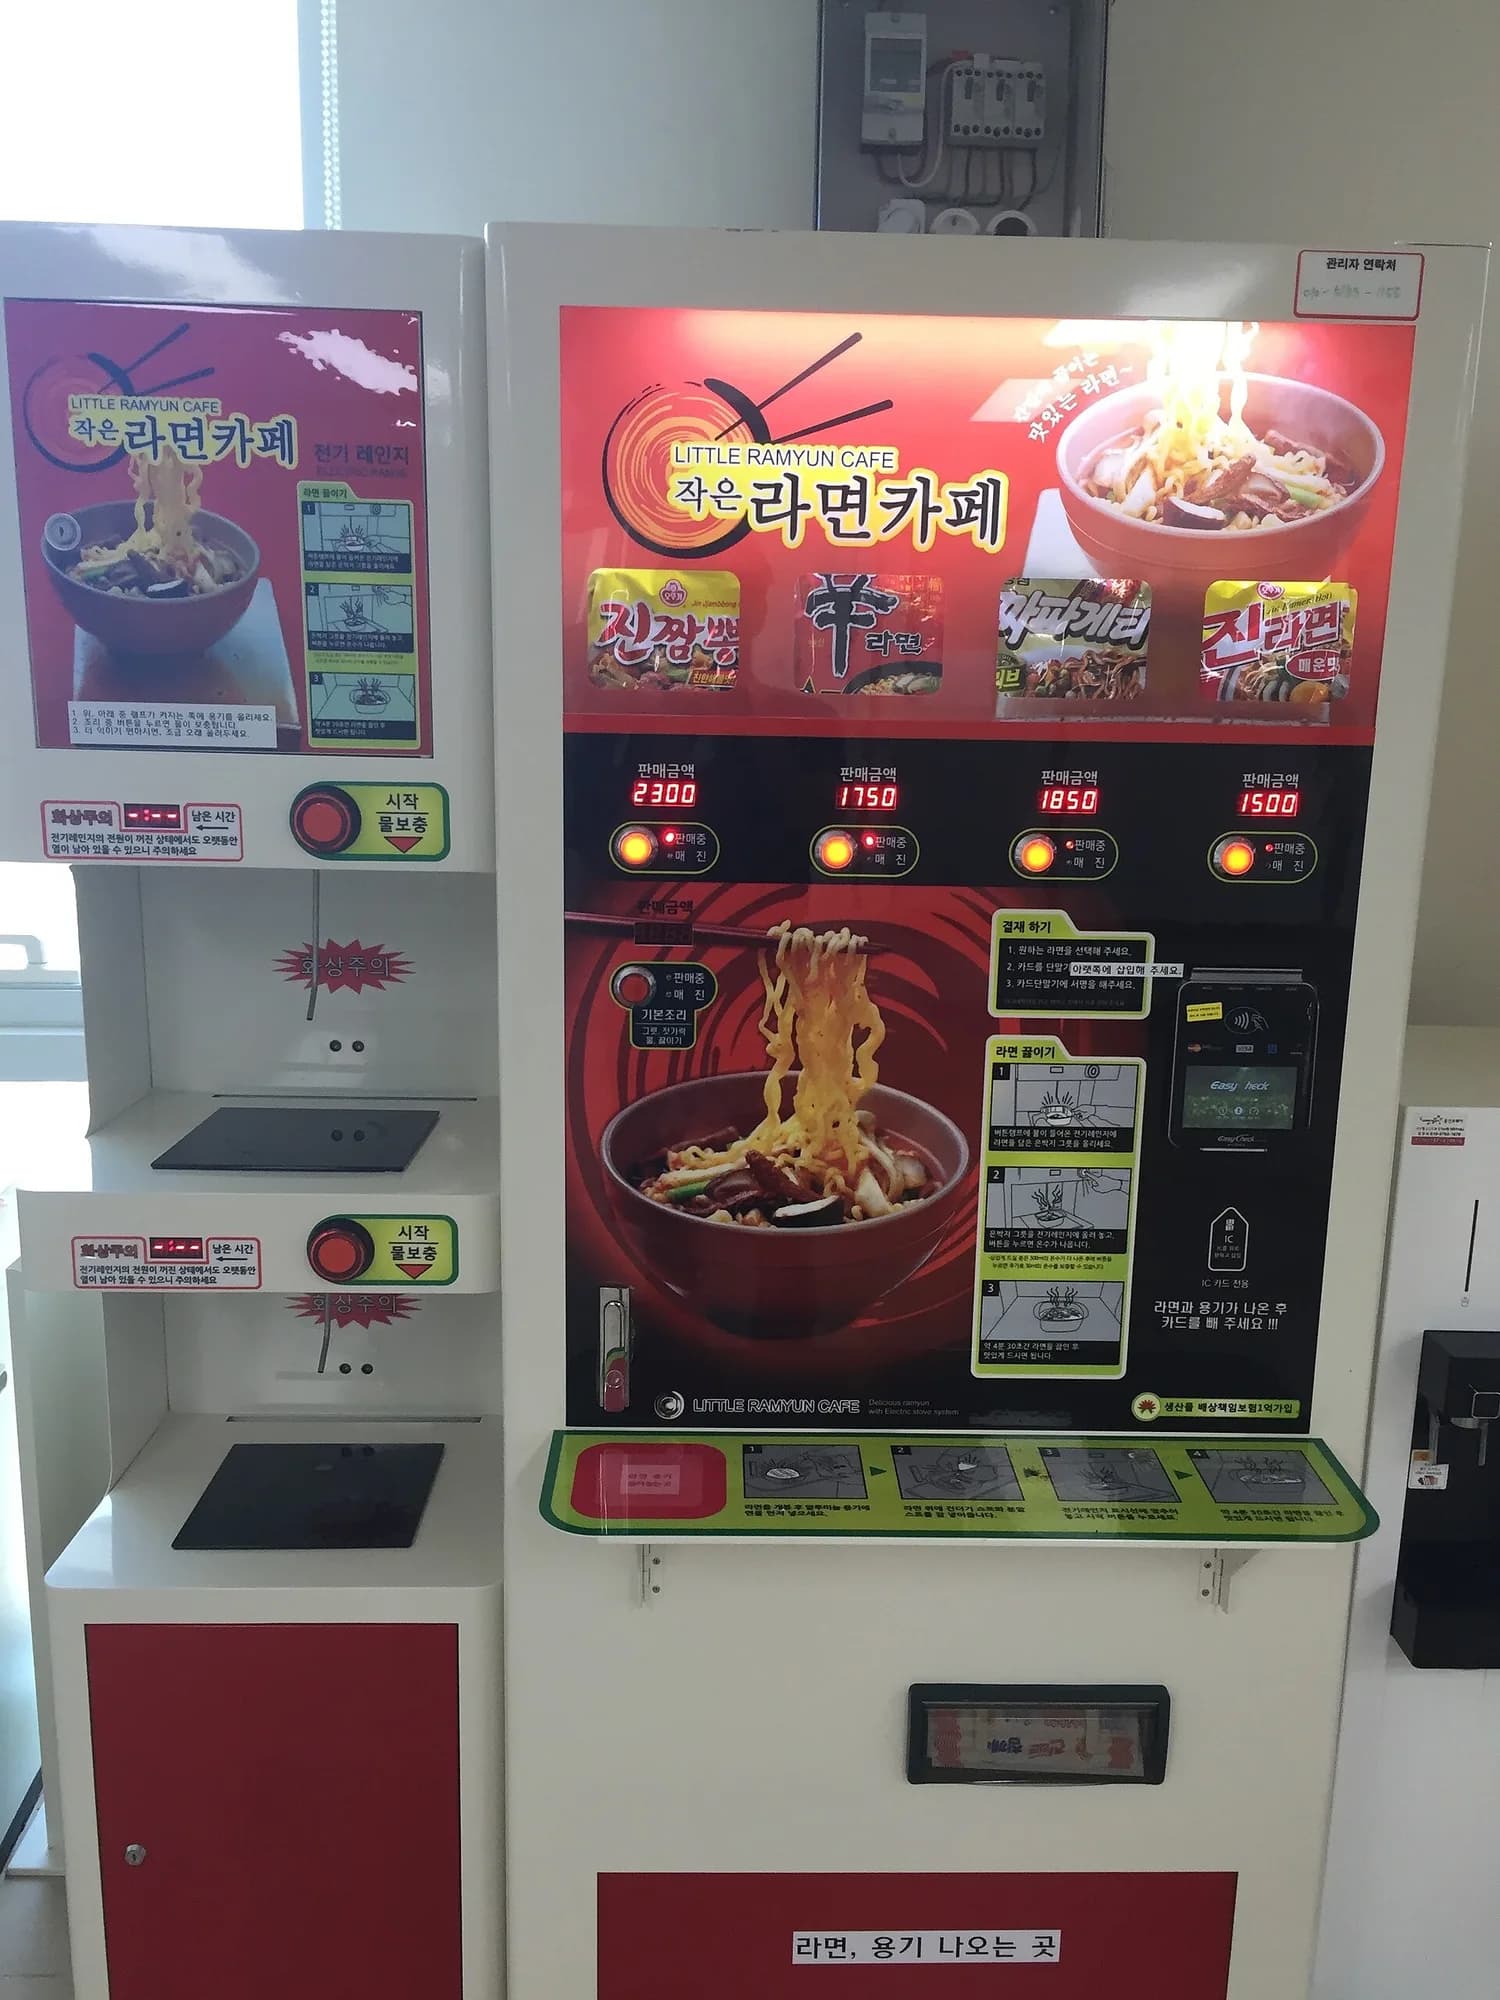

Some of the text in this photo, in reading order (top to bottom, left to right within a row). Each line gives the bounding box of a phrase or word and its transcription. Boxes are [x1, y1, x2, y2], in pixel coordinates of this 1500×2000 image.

[1326, 257, 1397, 271] 관리자 연락처
[71, 397, 219, 414] LITTLE RAMYUN CAFE
[1028, 393, 1078, 443] 맛있는
[73, 414, 295, 466] 작은 라면카페
[314, 443, 409, 465] 전기 레인지
[674, 446, 894, 470] LITTLE RAMYUN CAFE
[674, 472, 1001, 547] 작은 라면카페
[865, 629, 923, 657] 라면
[1201, 601, 1340, 671] 진라면
[98, 709, 233, 721] 아래 용기를
[117, 719, 170, 728] 버튼을 누르면
[167, 728, 202, 737] 조금 오래
[637, 763, 695, 780] 판매금액
[839, 766, 897, 783] 판매금액
[1041, 769, 1098, 787] 판매금액
[1242, 773, 1300, 789] 판매금액
[634, 783, 697, 804] 2300
[840, 786, 897, 808] 1750
[1042, 790, 1097, 811] 1850
[385, 793, 420, 811] 시작
[1242, 793, 1297, 814] 1500
[51, 808, 113, 827] 화상주의
[191, 810, 236, 823] 남은 시간
[377, 814, 430, 834] 물보충
[50, 832, 104, 843] 전기레인지의
[107, 833, 133, 844] 전원이
[135, 833, 153, 845] 꺼진
[156, 834, 200, 846] 상태에서도
[674, 832, 707, 846] 판매중
[874, 835, 908, 850] 판매중
[1074, 838, 1106, 852] 판매중
[51, 844, 70, 854] 열이
[72, 844, 90, 855] 남아
[112, 845, 122, 855] 수
[123, 845, 150, 856] 있으니
[152, 846, 197, 856] 주의하세요
[1273, 841, 1305, 856] 판매중
[674, 850, 707, 864] 매 진
[874, 853, 907, 867] 매 진
[1073, 856, 1106, 870] 매 진
[1272, 858, 1305, 873] 매 진
[1002, 920, 1052, 934] 결재 하기
[1018, 946, 1132, 957] 원하는 라면을 선택해 주세요.
[1017, 962, 1043, 973] 카드를
[1072, 965, 1182, 976] 아랫쪽에 삽입해 주세요.
[673, 972, 706, 985] 판매중
[1016, 979, 1136, 990] 카드단말기에 서명을 해주세요.
[673, 989, 706, 1001] 매 진
[641, 1008, 687, 1022] 기본조리
[996, 1046, 1056, 1059] 라면 끓이기
[1074, 1129, 1118, 1139] 전기레인지에
[993, 1170, 999, 1180] 2
[398, 1225, 430, 1241] 시작
[989, 1230, 1080, 1239] 은박지 그릇을 전기레인지에
[1224, 1234, 1234, 1244] IC
[79, 1243, 138, 1259] 화상주의
[212, 1243, 254, 1255] 남은 시간
[988, 1240, 1058, 1249] 버튼을 누르면 온수가
[389, 1245, 439, 1263] 물보충
[79, 1265, 130, 1275] 전기레인지의
[132, 1265, 157, 1275] 전원이
[159, 1266, 177, 1275] 꺼진
[178, 1266, 220, 1276] 상태에서도
[79, 1275, 97, 1285] 열이
[99, 1276, 117, 1285] 남아
[137, 1276, 147, 1285] 수
[148, 1276, 173, 1286] 있으니
[175, 1276, 217, 1286] 주의하세요
[1201, 1279, 1249, 1289] IC 카드 전용
[987, 1283, 994, 1293] 3
[1154, 1300, 1288, 1316] 라면과 용기가 나온 후
[1160, 1316, 1279, 1330] 카드를 빼 주세요 !!!
[692, 1398, 861, 1414] LITTLE RAMYUN CAFE
[902, 1400, 931, 1409] ramyun
[796, 1935, 1056, 1960] 라면, 용기 나오는 곳
